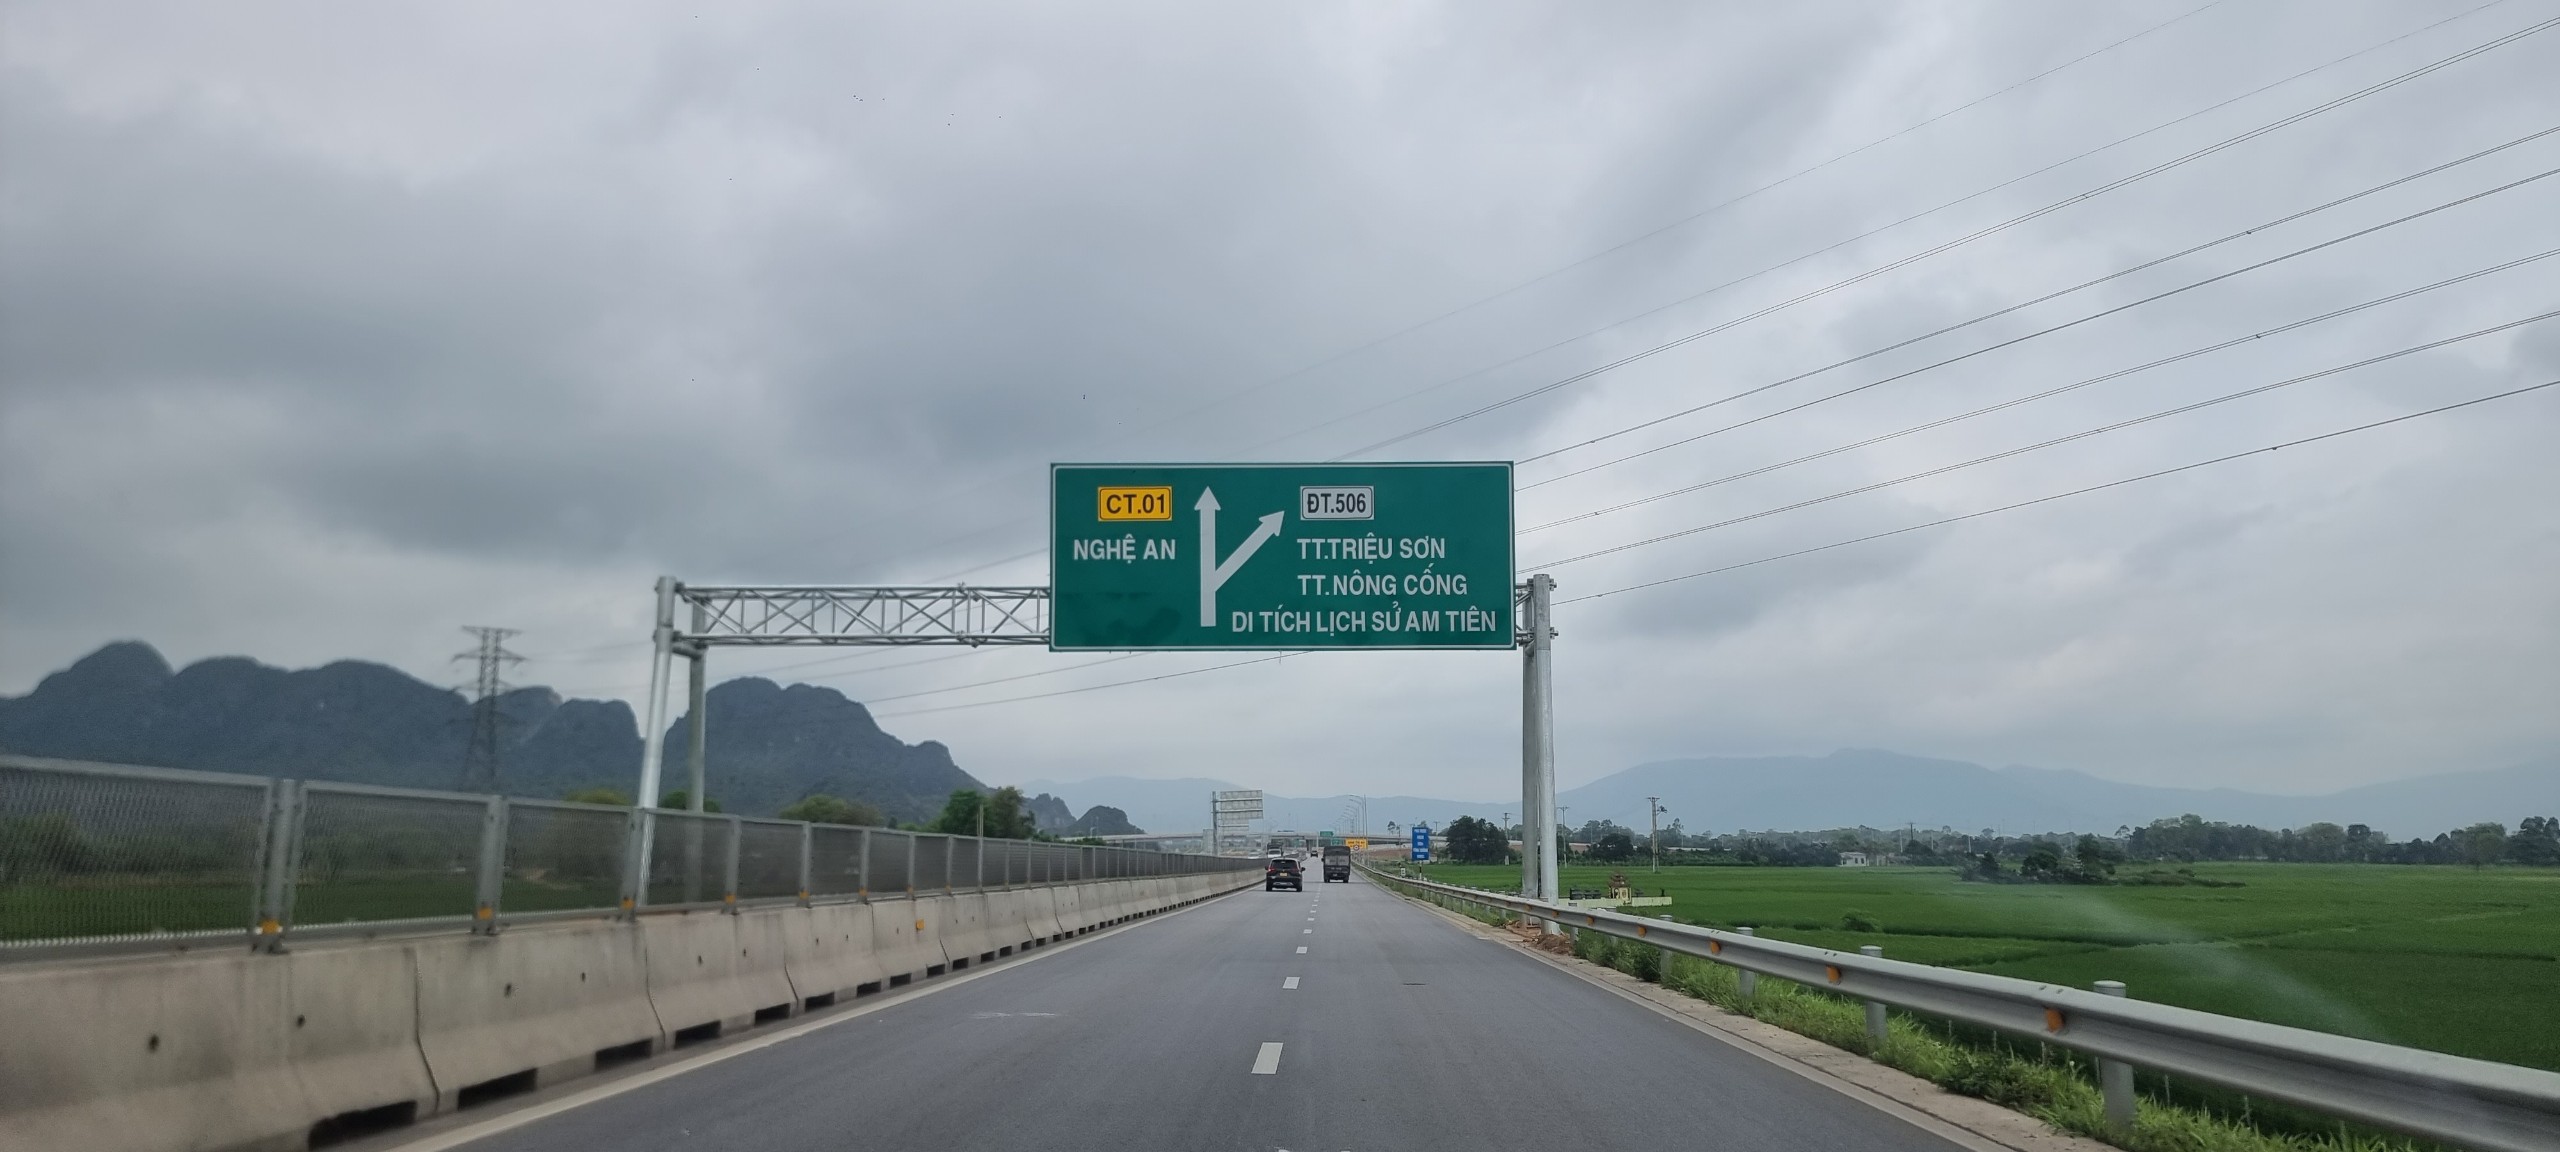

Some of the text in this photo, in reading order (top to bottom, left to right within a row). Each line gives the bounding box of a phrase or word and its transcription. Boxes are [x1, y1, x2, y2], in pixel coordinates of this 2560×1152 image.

[1106, 494, 1166, 514] CT.01
[1307, 493, 1366, 513] ĐT.506
[1074, 534, 1175, 563] NGHỆ AN
[1400, 536, 1445, 559] SƠN
[1404, 563, 1467, 595] CỐNG
[1233, 601, 1495, 636] DI TÍCH LỊCH SỬ AM TIÊN
